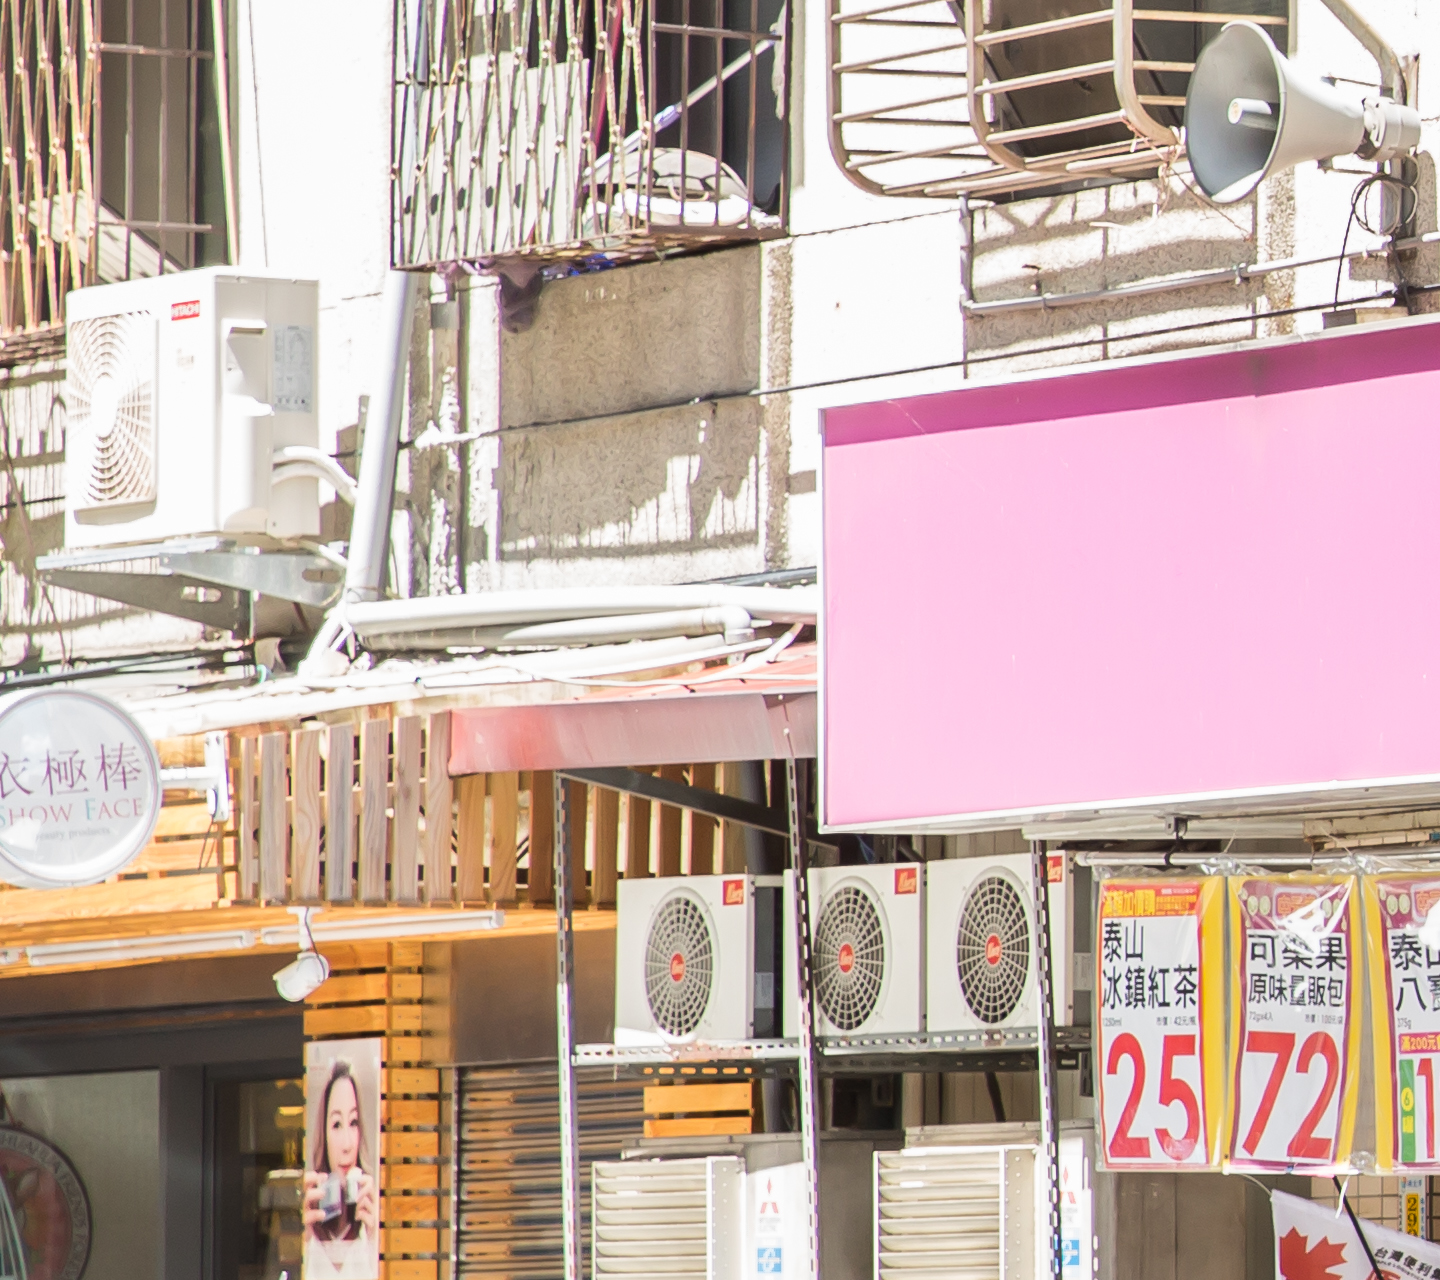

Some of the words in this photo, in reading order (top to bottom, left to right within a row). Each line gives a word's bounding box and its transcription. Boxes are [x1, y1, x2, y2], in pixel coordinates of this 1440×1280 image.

[1103, 920, 1144, 963] 泰山
[1102, 964, 1197, 1010] 冰鎮紅茶
[1248, 973, 1344, 1008] 原味量販包
[1106, 1031, 1200, 1160] 25
[1243, 1031, 1340, 1159] 72
